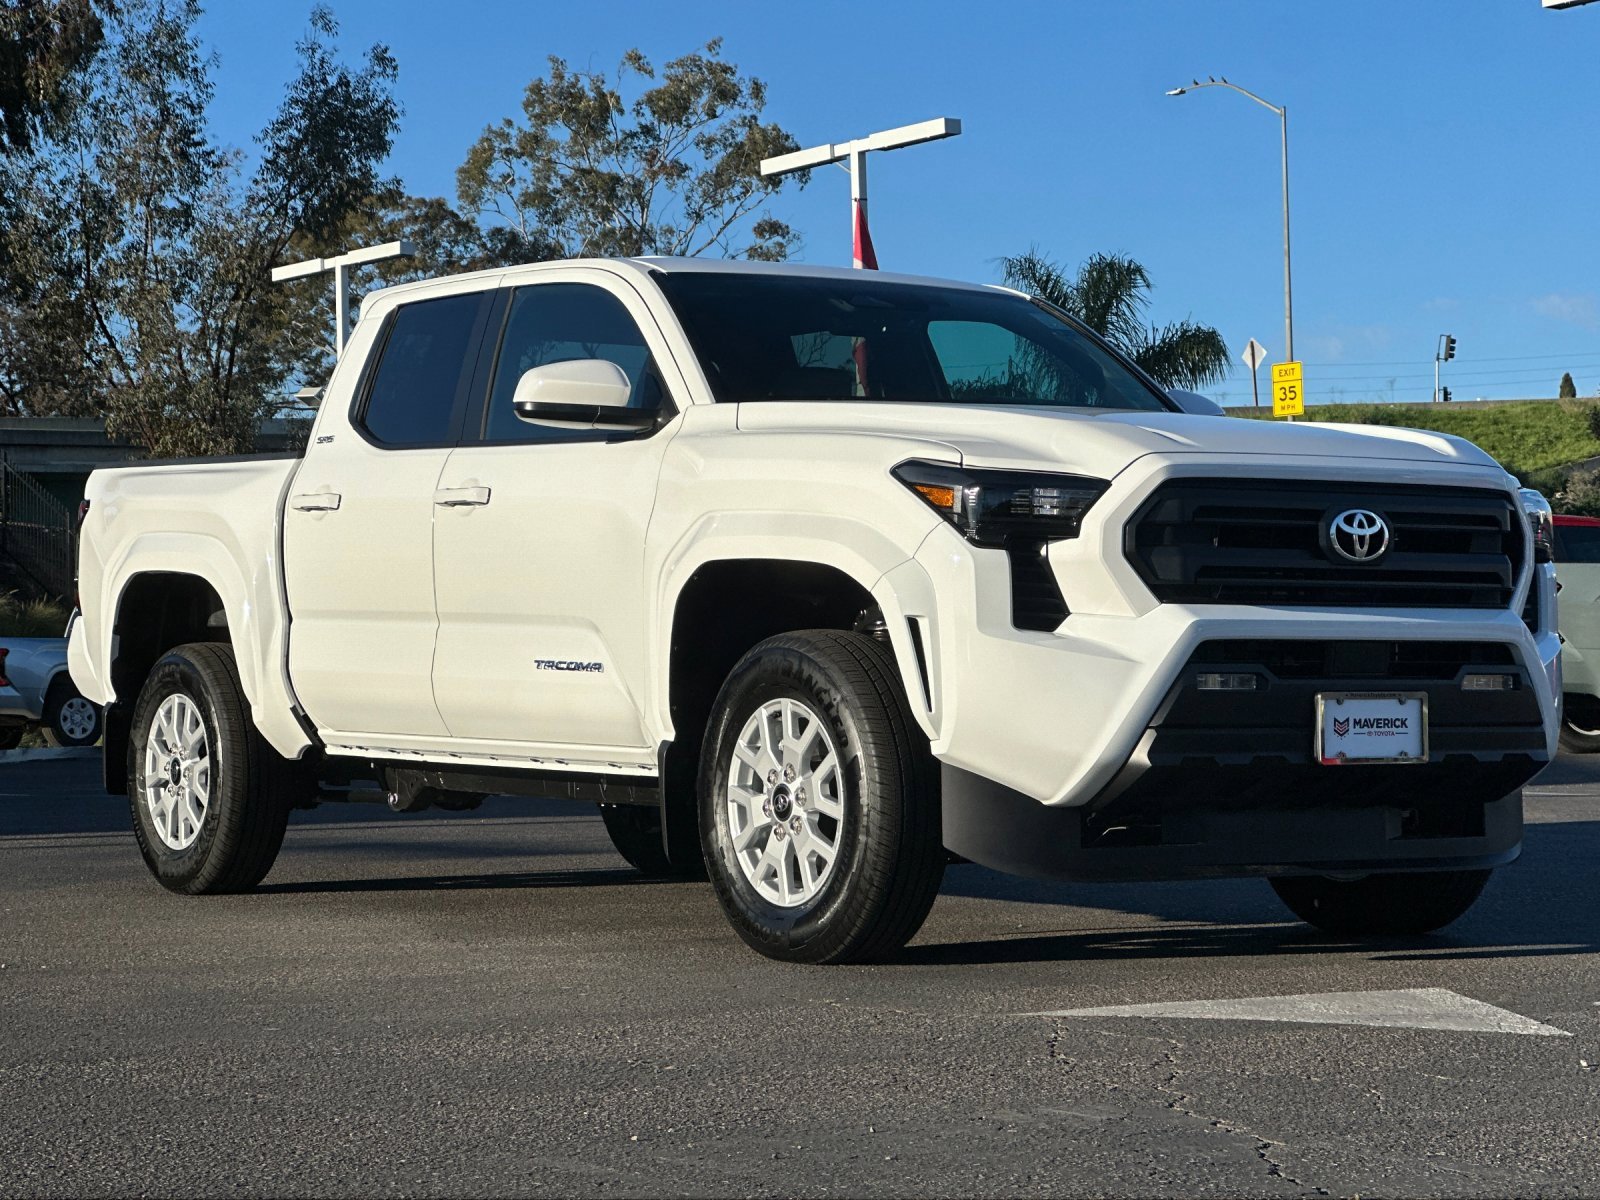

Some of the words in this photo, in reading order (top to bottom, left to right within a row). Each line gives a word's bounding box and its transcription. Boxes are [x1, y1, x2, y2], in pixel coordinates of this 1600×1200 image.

[1278, 368, 1296, 377] EXIT
[1279, 385, 1297, 402] 35
[534, 659, 604, 673] TACOMA
[1353, 717, 1408, 729] MAVERICK
